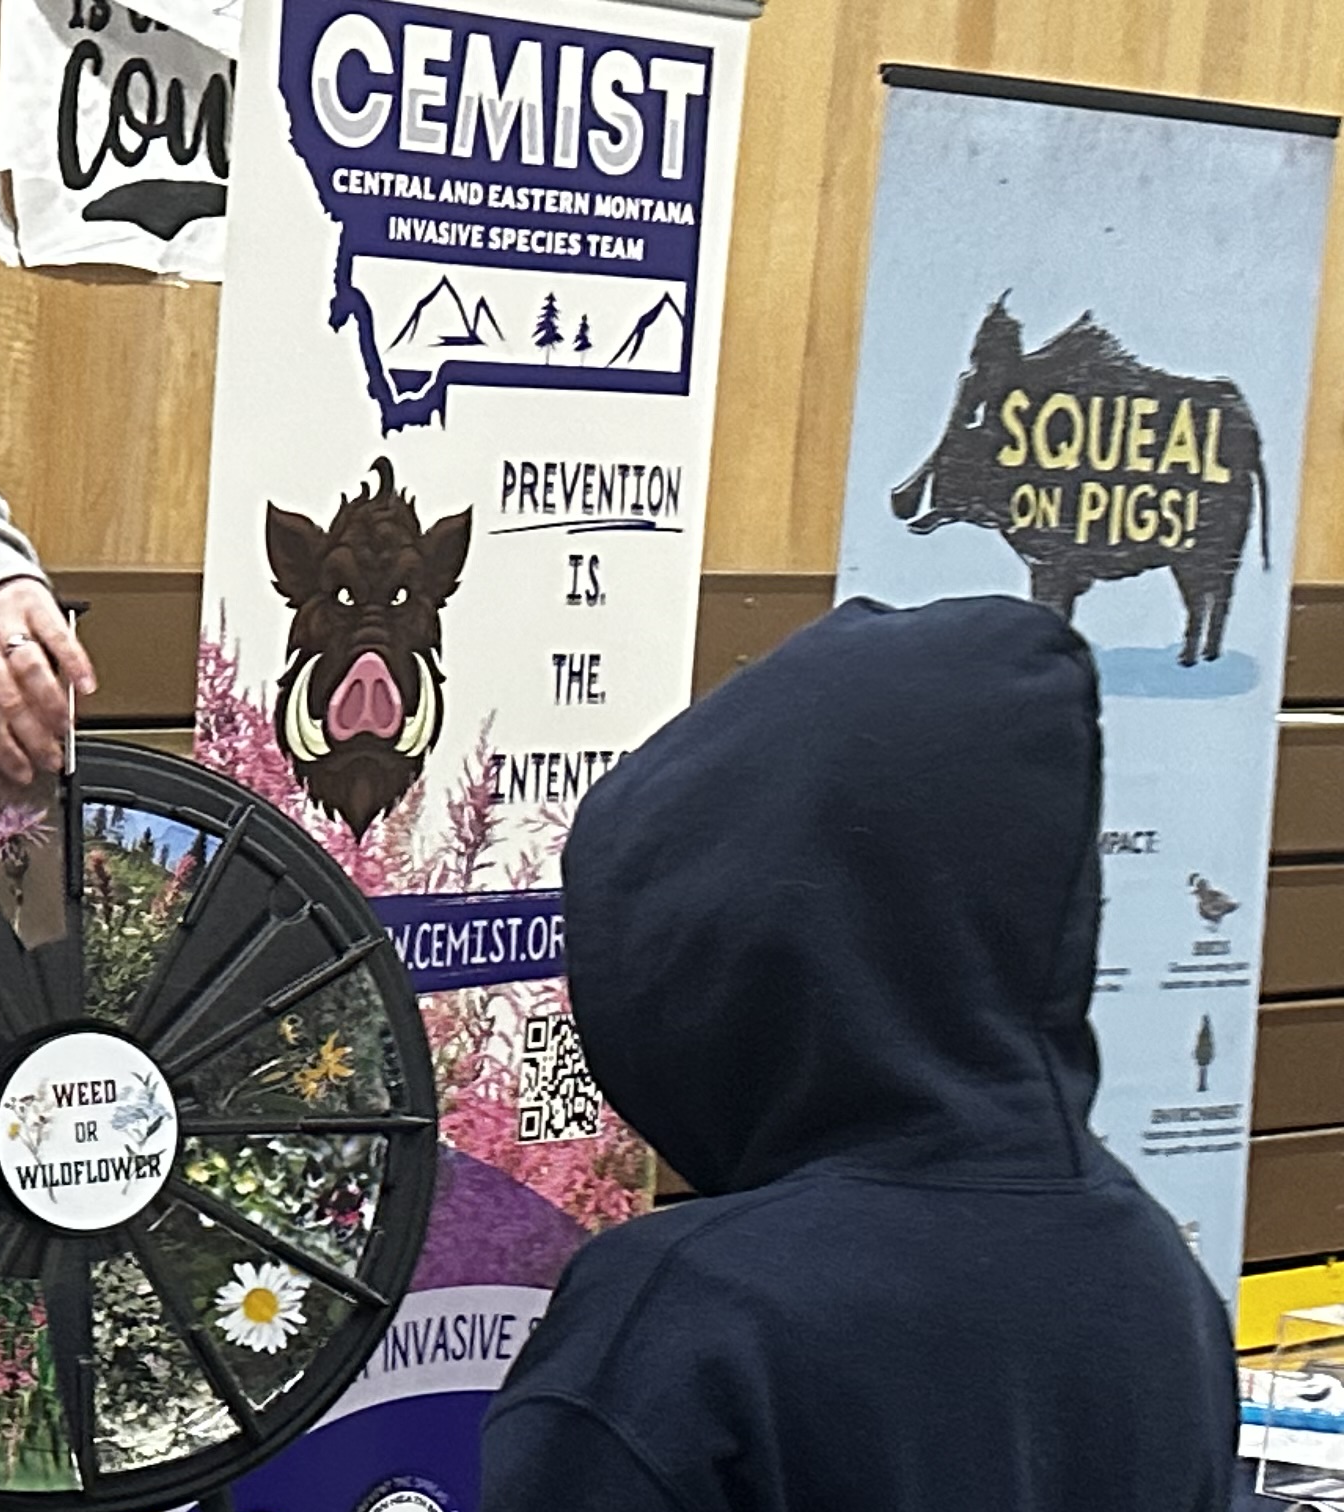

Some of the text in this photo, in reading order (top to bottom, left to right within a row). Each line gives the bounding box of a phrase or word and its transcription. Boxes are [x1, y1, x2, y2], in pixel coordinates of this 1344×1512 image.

[311, 13, 707, 180] CEMIST
[332, 167, 695, 226] CENTRAL AND EASTERN MONTANA
[388, 215, 644, 262] INVASIVE SPECIES TEAM
[997, 388, 1231, 484] SQUEAL
[500, 459, 682, 516] PREVENTION
[1011, 481, 1200, 551] ON PIGS!
[52, 1079, 118, 1108] WEED
[74, 1120, 99, 1144] OR
[15, 1154, 163, 1190] WILDFLOWER
[383, 1313, 517, 1372] INVASIVE
